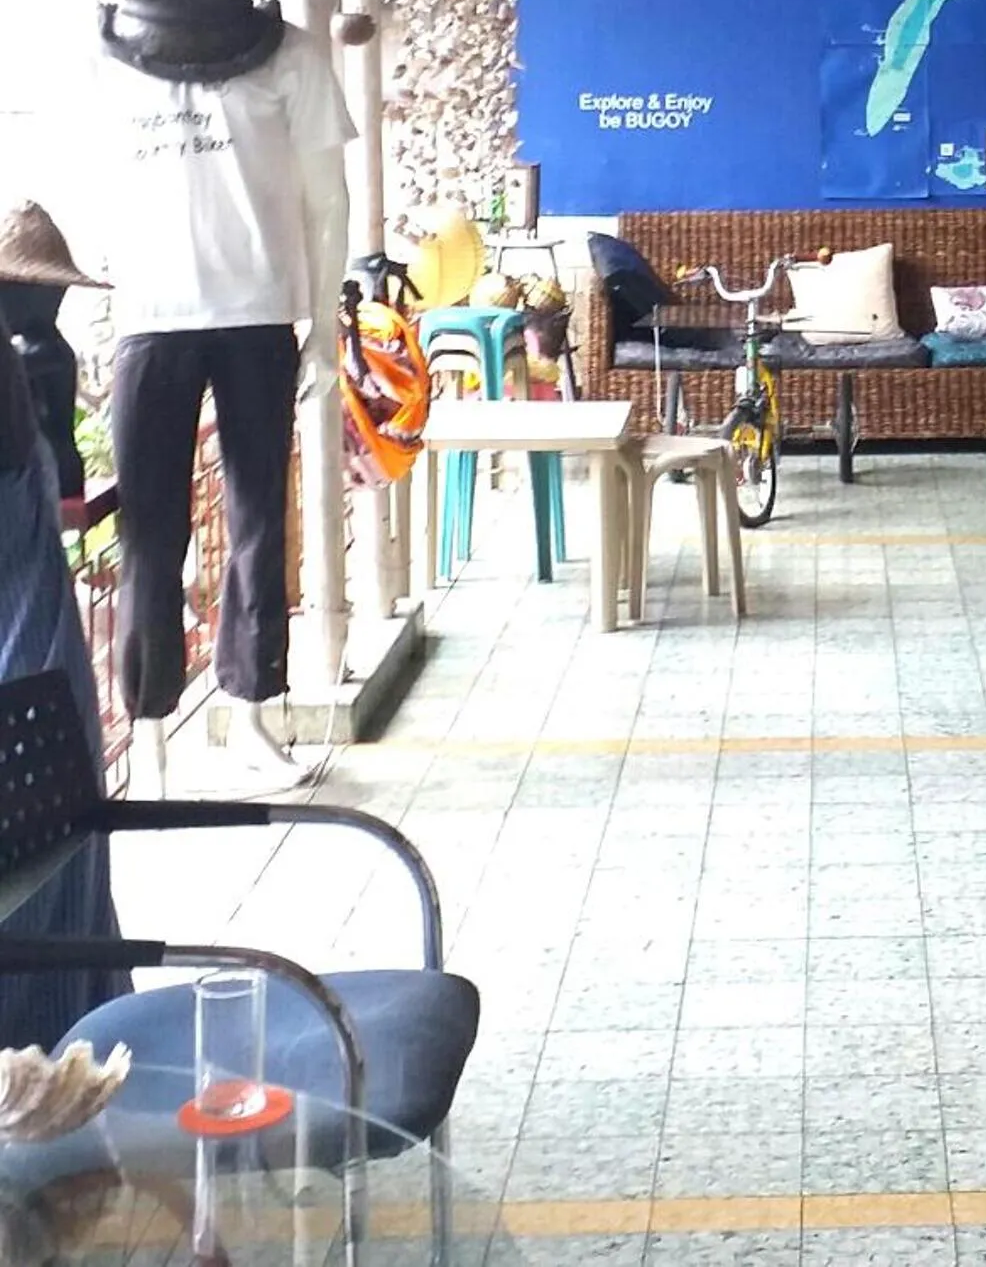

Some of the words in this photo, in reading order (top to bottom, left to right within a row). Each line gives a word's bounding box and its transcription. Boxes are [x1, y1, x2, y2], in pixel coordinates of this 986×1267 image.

[578, 92, 645, 113] Explore
[647, 93, 661, 110] &
[664, 92, 714, 114] Enjoy
[599, 110, 622, 129] be
[625, 111, 693, 129] BUGOY
